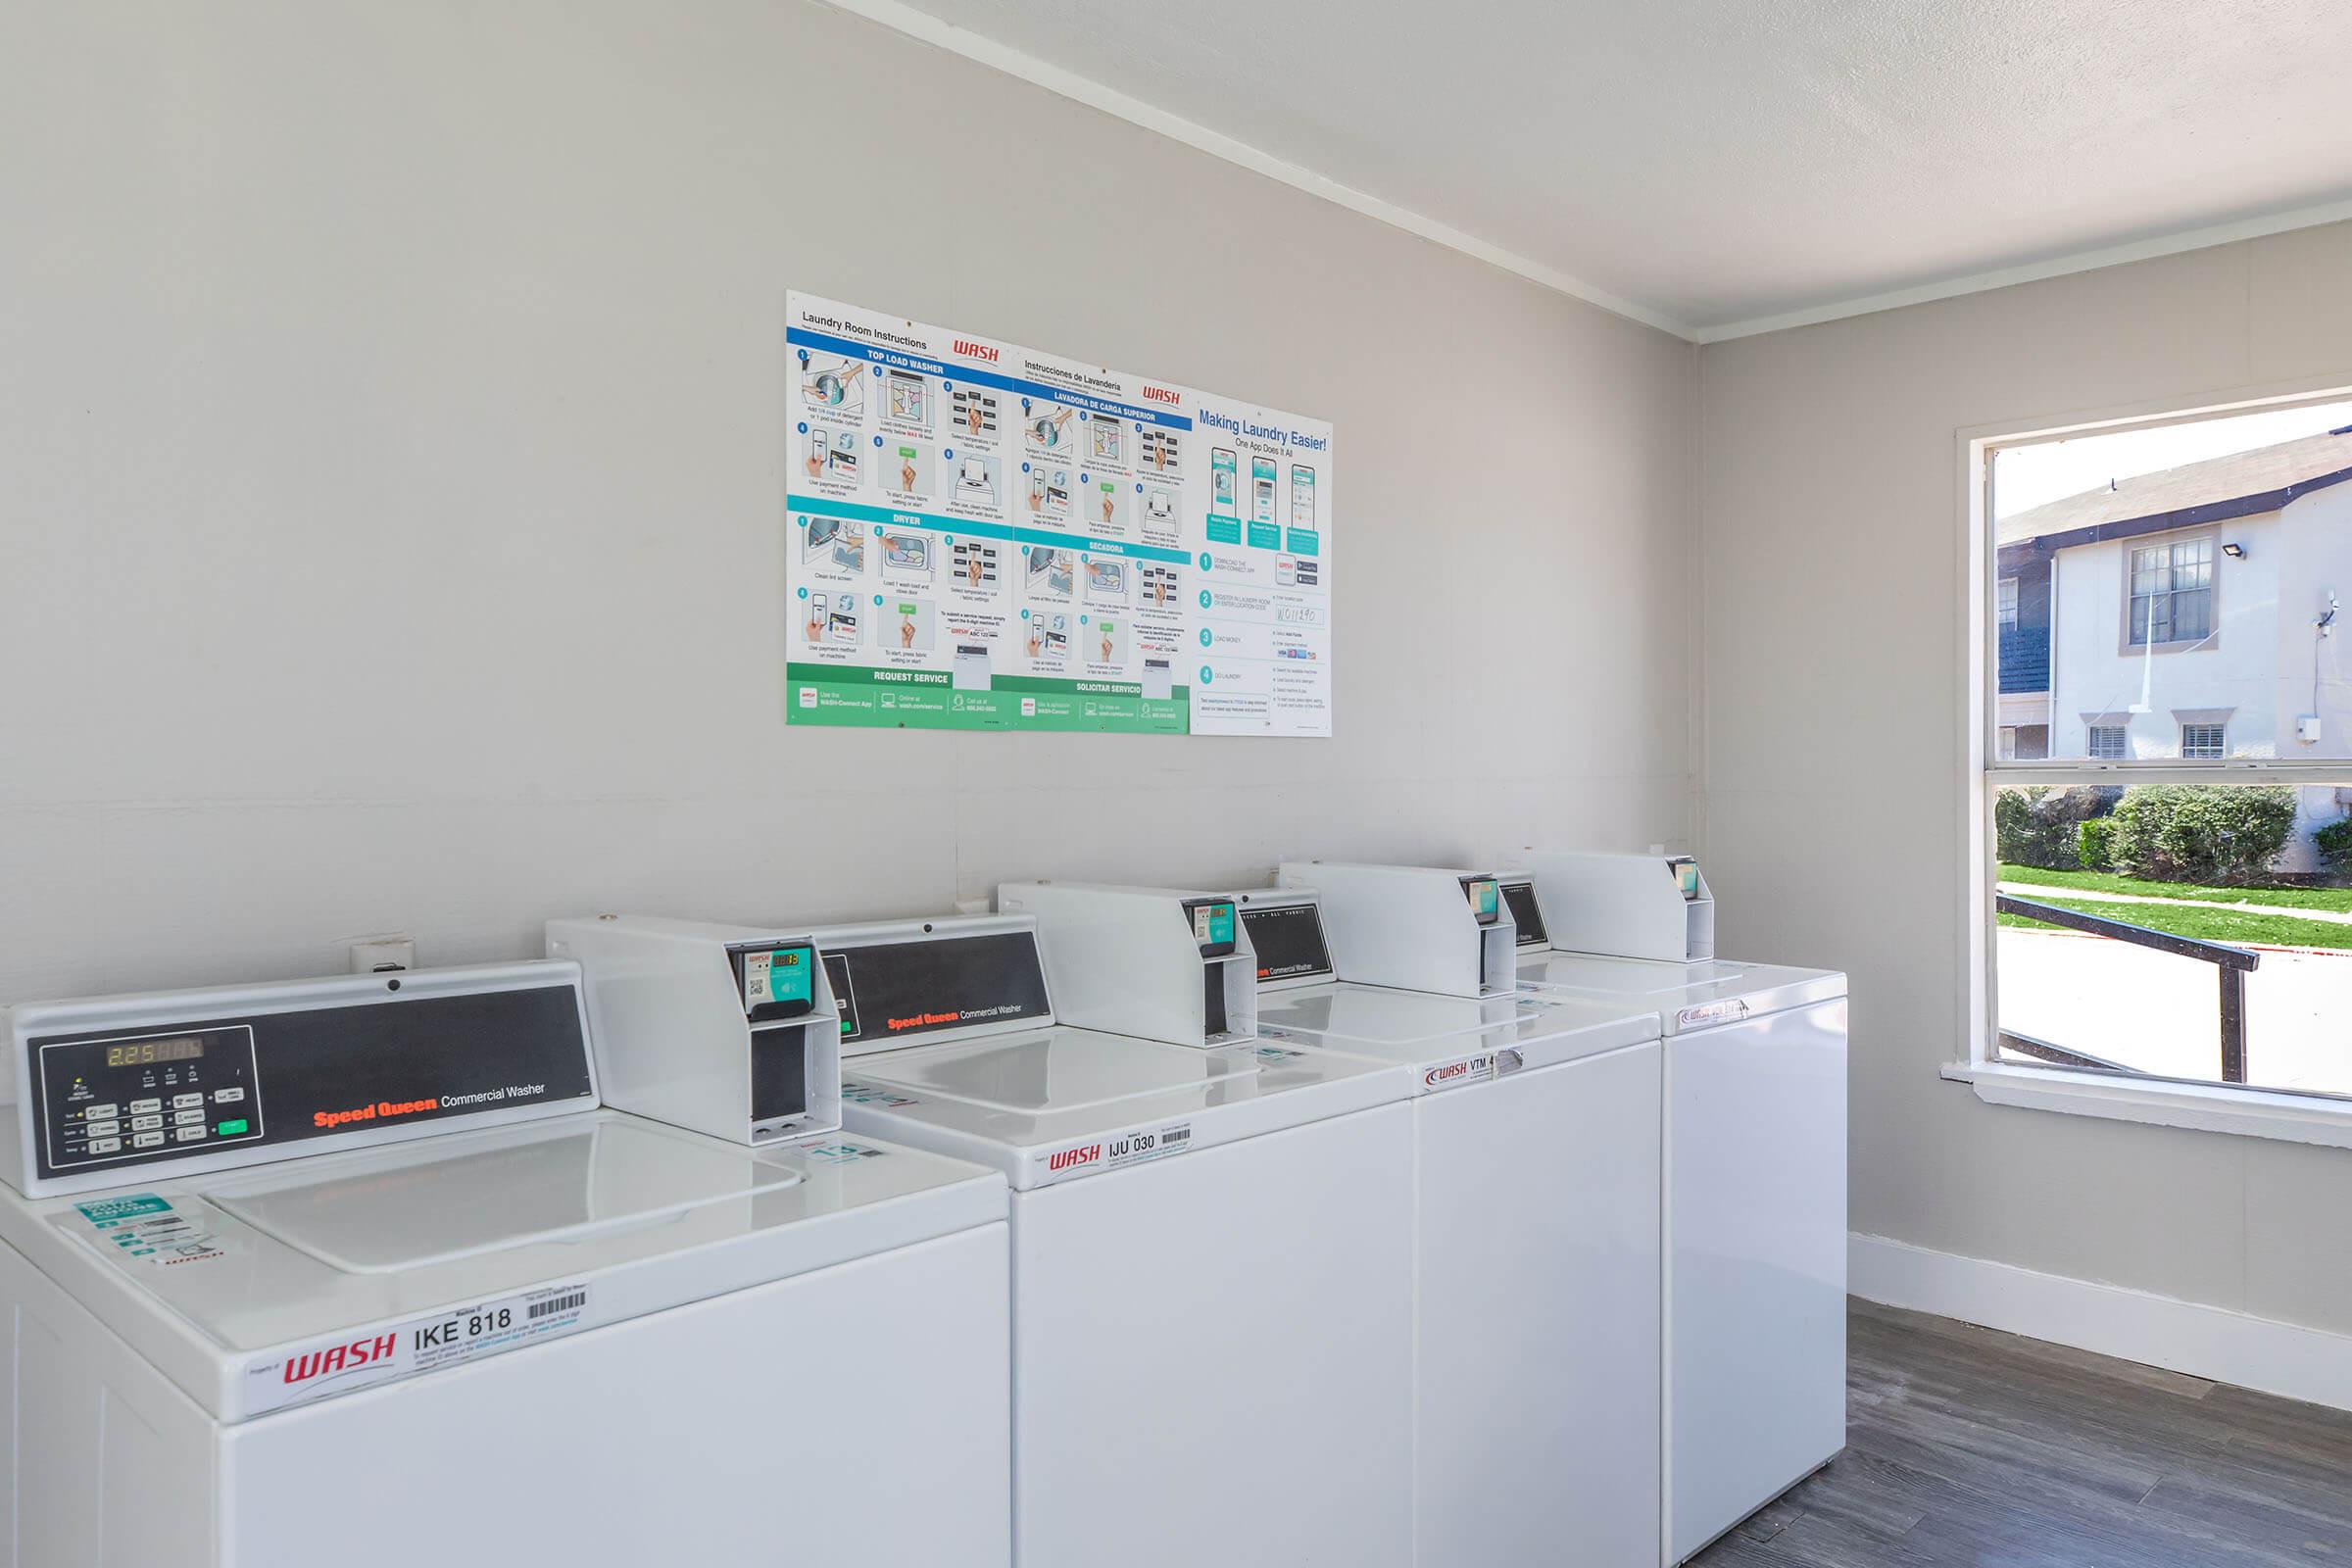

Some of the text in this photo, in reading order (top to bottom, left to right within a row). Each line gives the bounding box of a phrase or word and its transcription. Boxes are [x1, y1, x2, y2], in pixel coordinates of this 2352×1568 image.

[803, 311, 842, 330] Laundry
[845, 321, 872, 336] Room
[874, 329, 927, 350] Instructions
[953, 339, 1000, 362] WASH
[867, 350, 944, 374] TOP LOAD WASHER
[1025, 360, 1072, 379] Instrucciones
[1074, 373, 1083, 382] de
[1054, 392, 1155, 421] LAVADORA DE CARGA SUPERIOR
[1143, 386, 1180, 405] WASH
[842, 412, 863, 421] detergent
[965, 435, 988, 444] temperature
[1200, 409, 1327, 452] Making Laundry Easier!
[1235, 437, 1294, 458] One App Does It All
[893, 514, 921, 526] DRYER
[1089, 542, 1124, 554] SECADORA
[1214, 557, 1239, 566] DOWNLOAD
[873, 670, 949, 684] REQUEST SERVICE
[1076, 682, 1141, 694] SOLICITAR SERVICIO
[1269, 964, 1296, 975] Commercial
[1296, 962, 1312, 972] Washer
[887, 1004, 1022, 1031] Speed Queen Commercial Washer
[1439, 1061, 1467, 1080] WASH
[1470, 1057, 1487, 1070] VTM
[314, 1083, 546, 1128] Speed Queen Commercial Washer
[1050, 1144, 1101, 1171] WASH
[1109, 1140, 1129, 1158] IJU
[1133, 1135, 1154, 1152] 030
[456, 1307, 476, 1317] Machine
[415, 1308, 512, 1350] IKE 818
[283, 1332, 397, 1385] WASH
